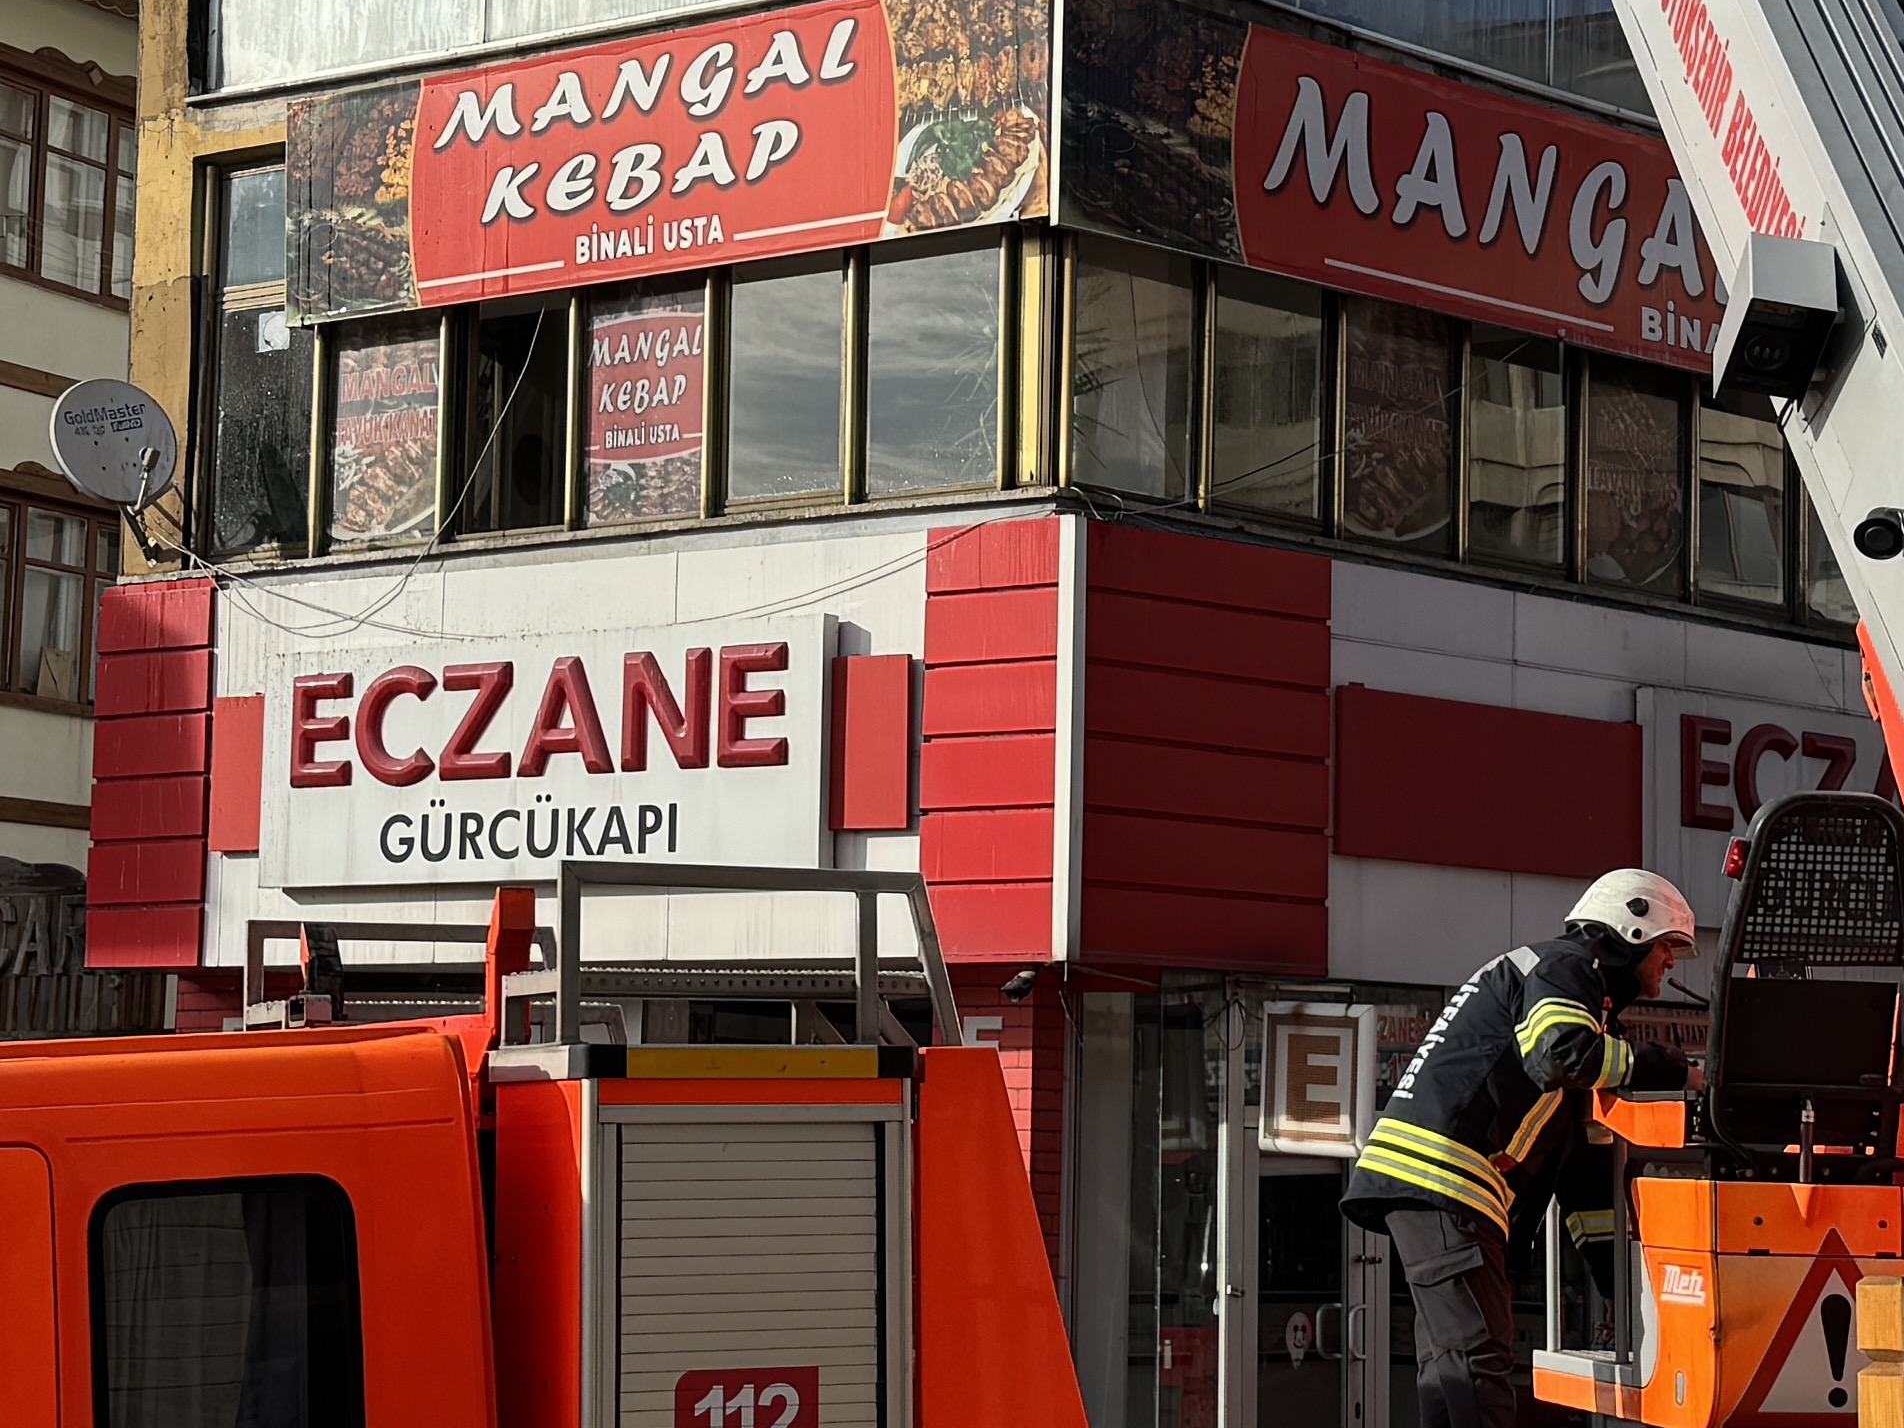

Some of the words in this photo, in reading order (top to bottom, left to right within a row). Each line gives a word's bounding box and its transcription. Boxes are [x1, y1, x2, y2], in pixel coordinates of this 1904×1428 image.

[432, 15, 859, 152] MANGAL
[479, 119, 803, 225] KEBAP
[1262, 75, 1728, 306] MANGA
[574, 215, 658, 265] BİNALİ
[663, 215, 725, 250] USTA
[587, 325, 704, 368] MANGAL
[340, 363, 435, 403] MANGAL
[598, 373, 688, 414] KEBAP
[64, 403, 146, 425] GoldMaster
[604, 421, 646, 449] BİNALİ
[649, 423, 680, 444] USTA
[289, 641, 790, 789] ECZANE
[379, 794, 679, 863] GÜRCÜKAPI
